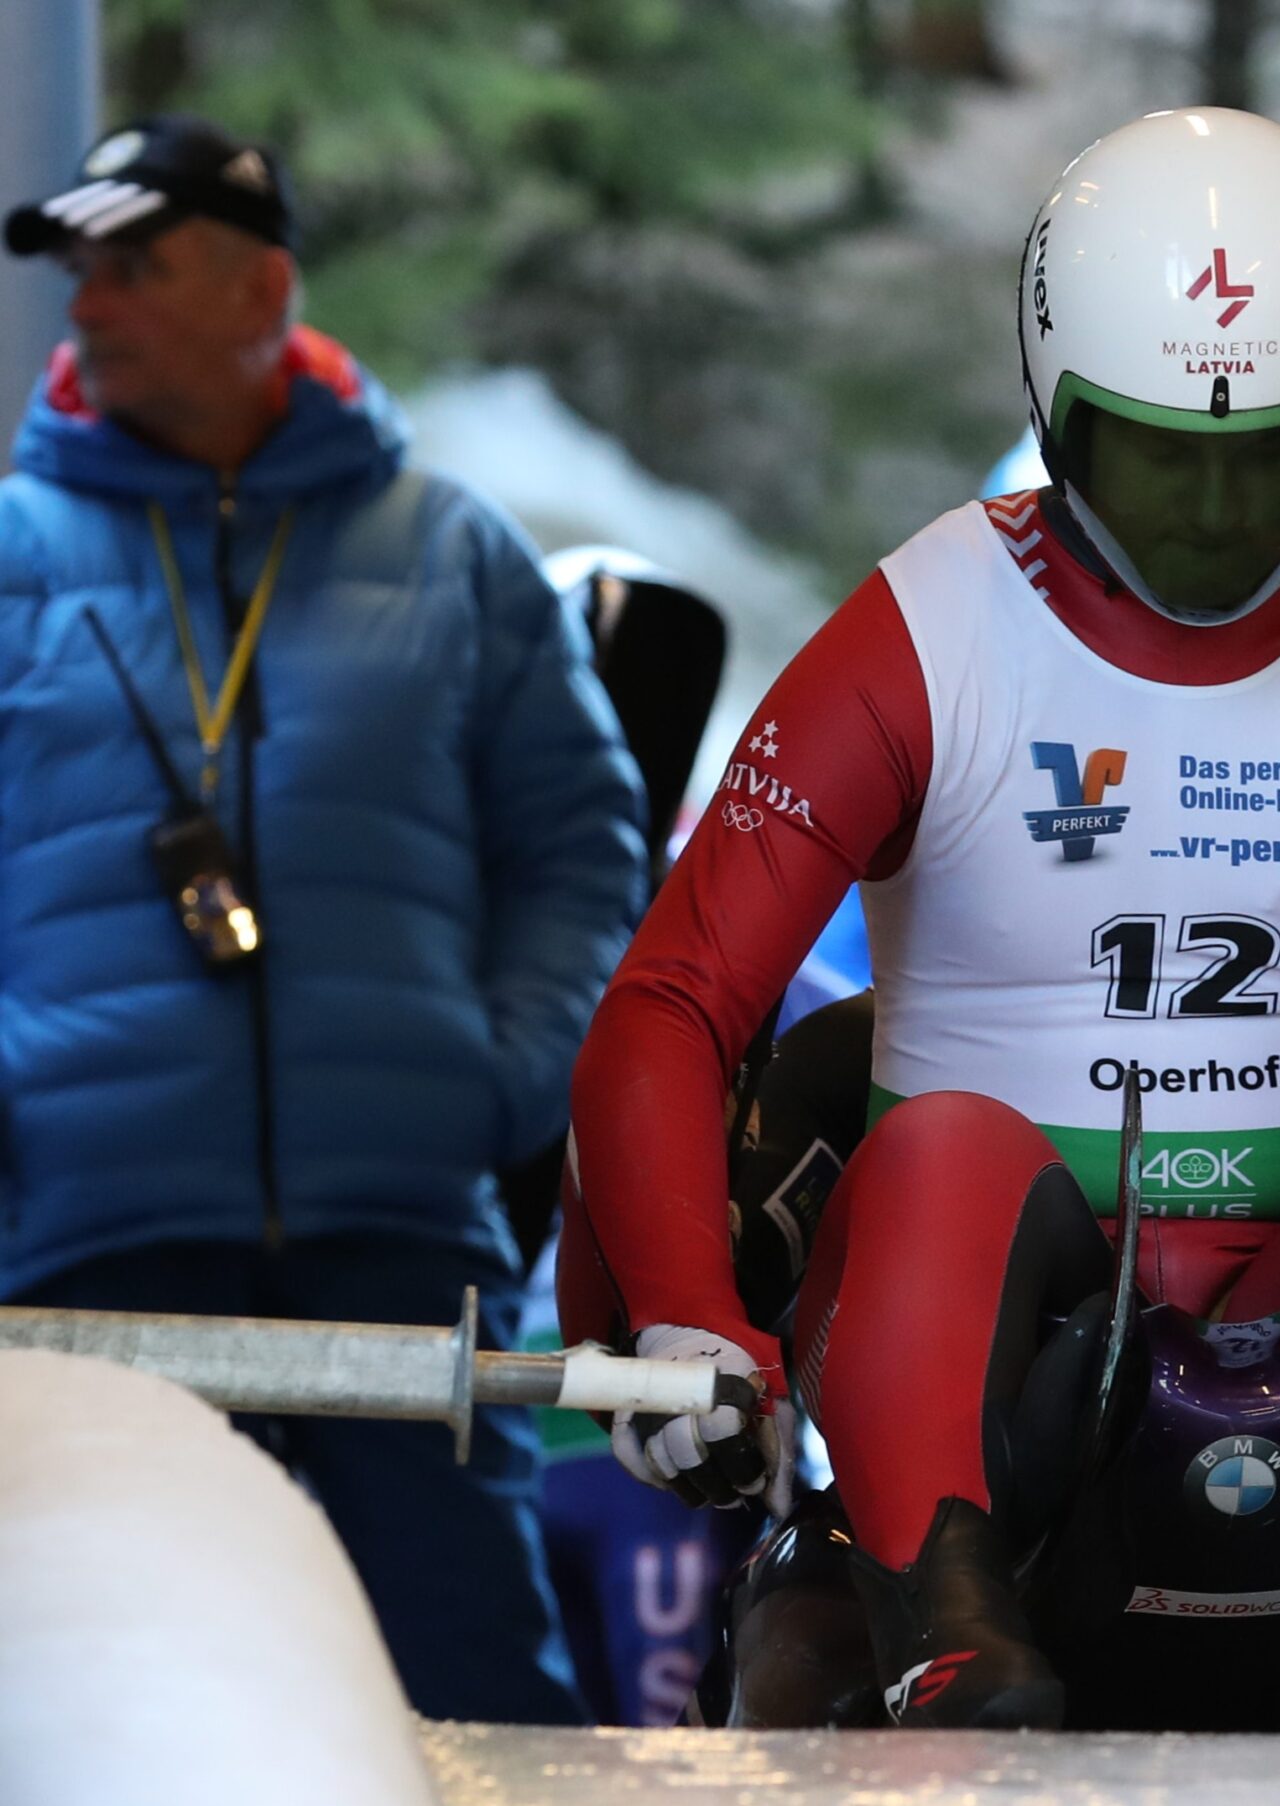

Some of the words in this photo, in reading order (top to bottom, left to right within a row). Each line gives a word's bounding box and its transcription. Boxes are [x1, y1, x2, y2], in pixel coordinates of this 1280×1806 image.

[1162, 340, 1279, 356] MAGNETIC
[1185, 360, 1255, 374] LATVIA
[1179, 755, 1230, 780] Das
[716, 762, 815, 828] ATVIJA
[1052, 815, 1111, 833] PERFEKT
[1089, 1055, 1280, 1093] Oberhof
